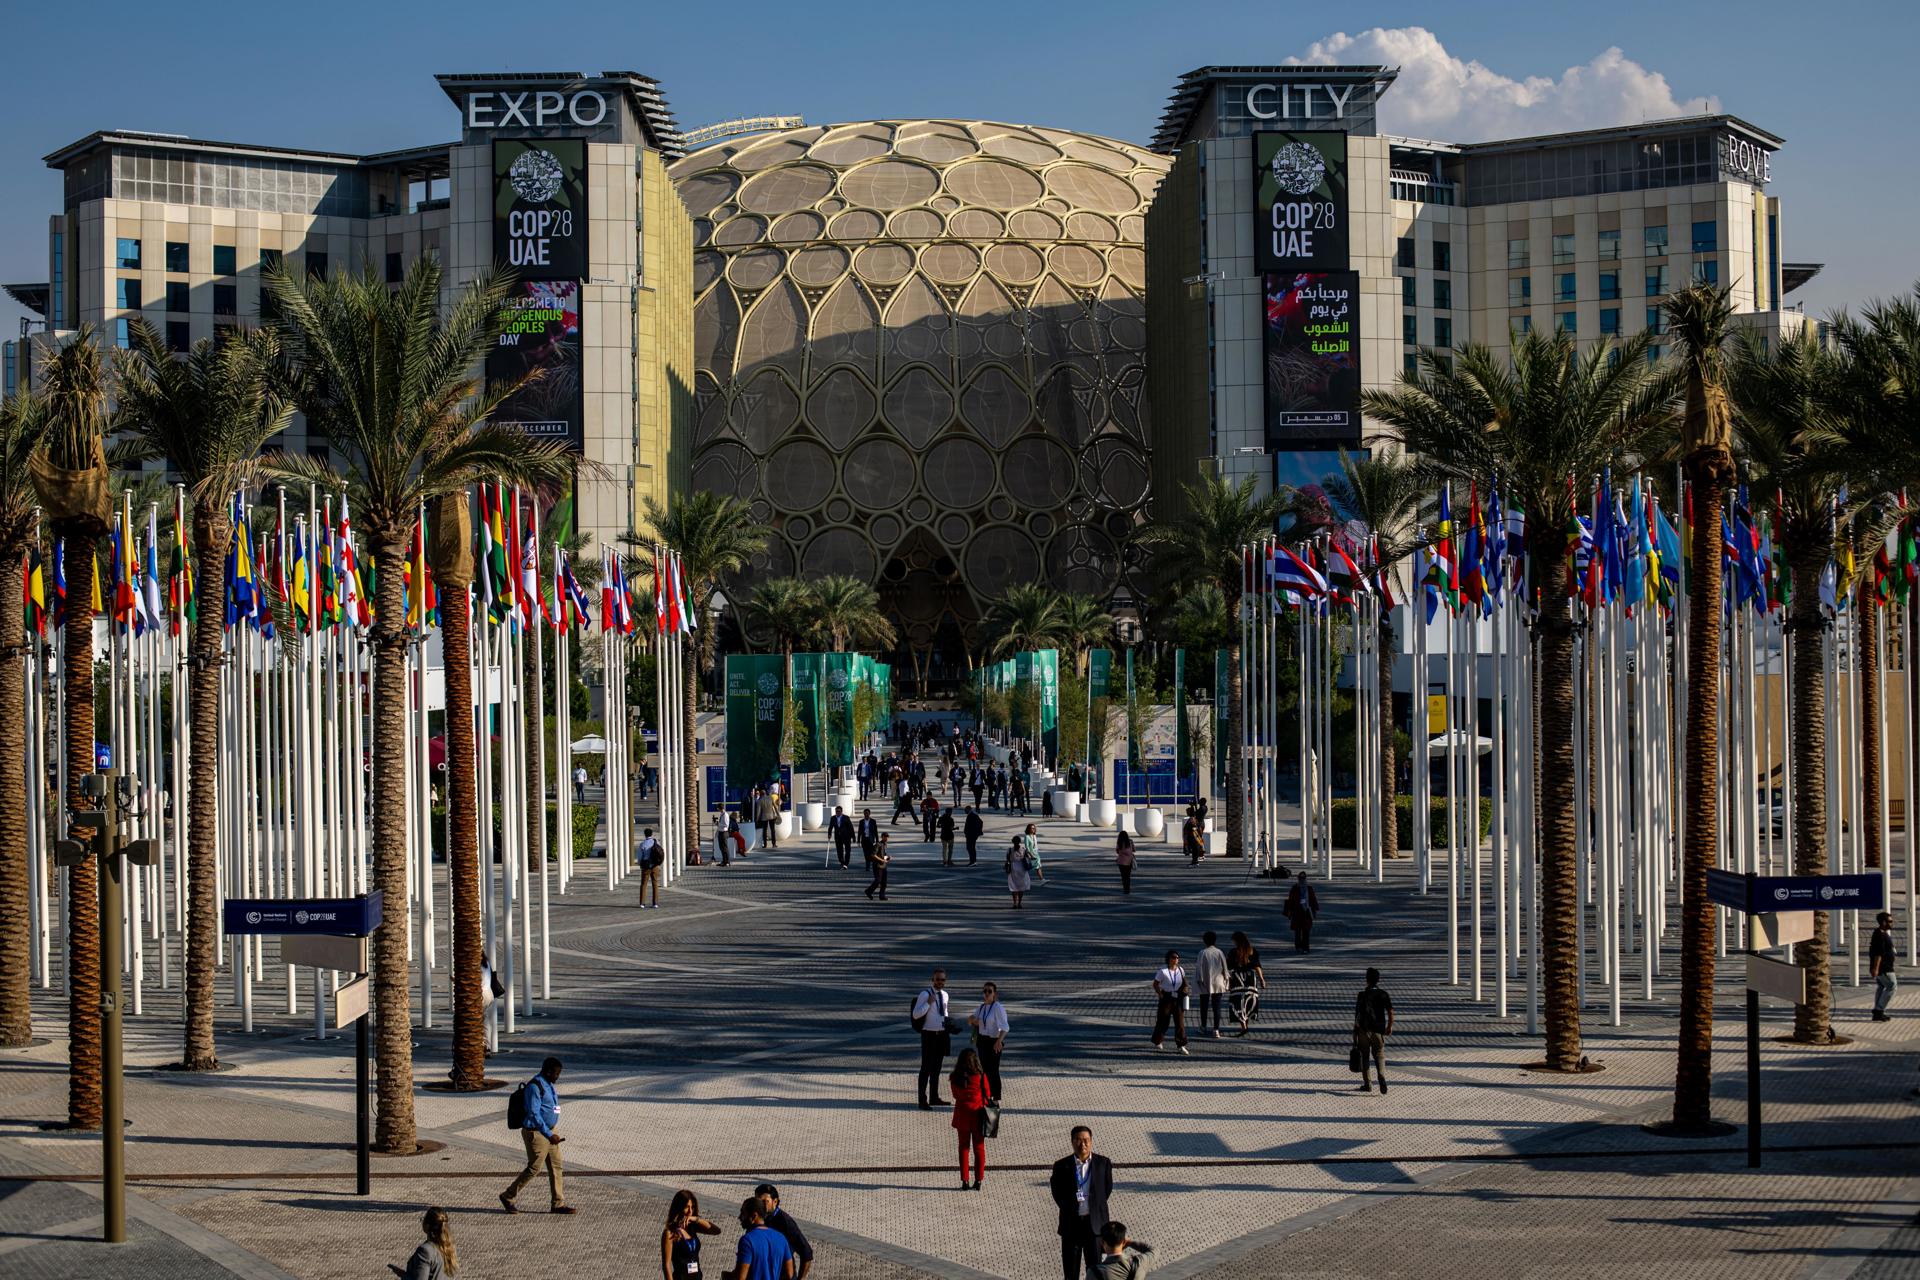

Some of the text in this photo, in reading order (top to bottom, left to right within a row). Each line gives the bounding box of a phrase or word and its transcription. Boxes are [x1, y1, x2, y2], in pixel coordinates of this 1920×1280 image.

[468, 90, 607, 128] EXPO
[1246, 83, 1355, 119] CITY
[1728, 134, 1772, 182] ROVE
[509, 209, 573, 238] COP28
[1272, 202, 1335, 230] COP28
[509, 238, 551, 266] UAE
[1272, 230, 1314, 258] UAE
[552, 297, 566, 308] TO
[1295, 287, 1317, 304] بكم
[1310, 302, 1348, 320] في يوم
[499, 334, 520, 346] DAY
[1304, 320, 1349, 336] الشعوب
[758, 709, 775, 721] UAE
